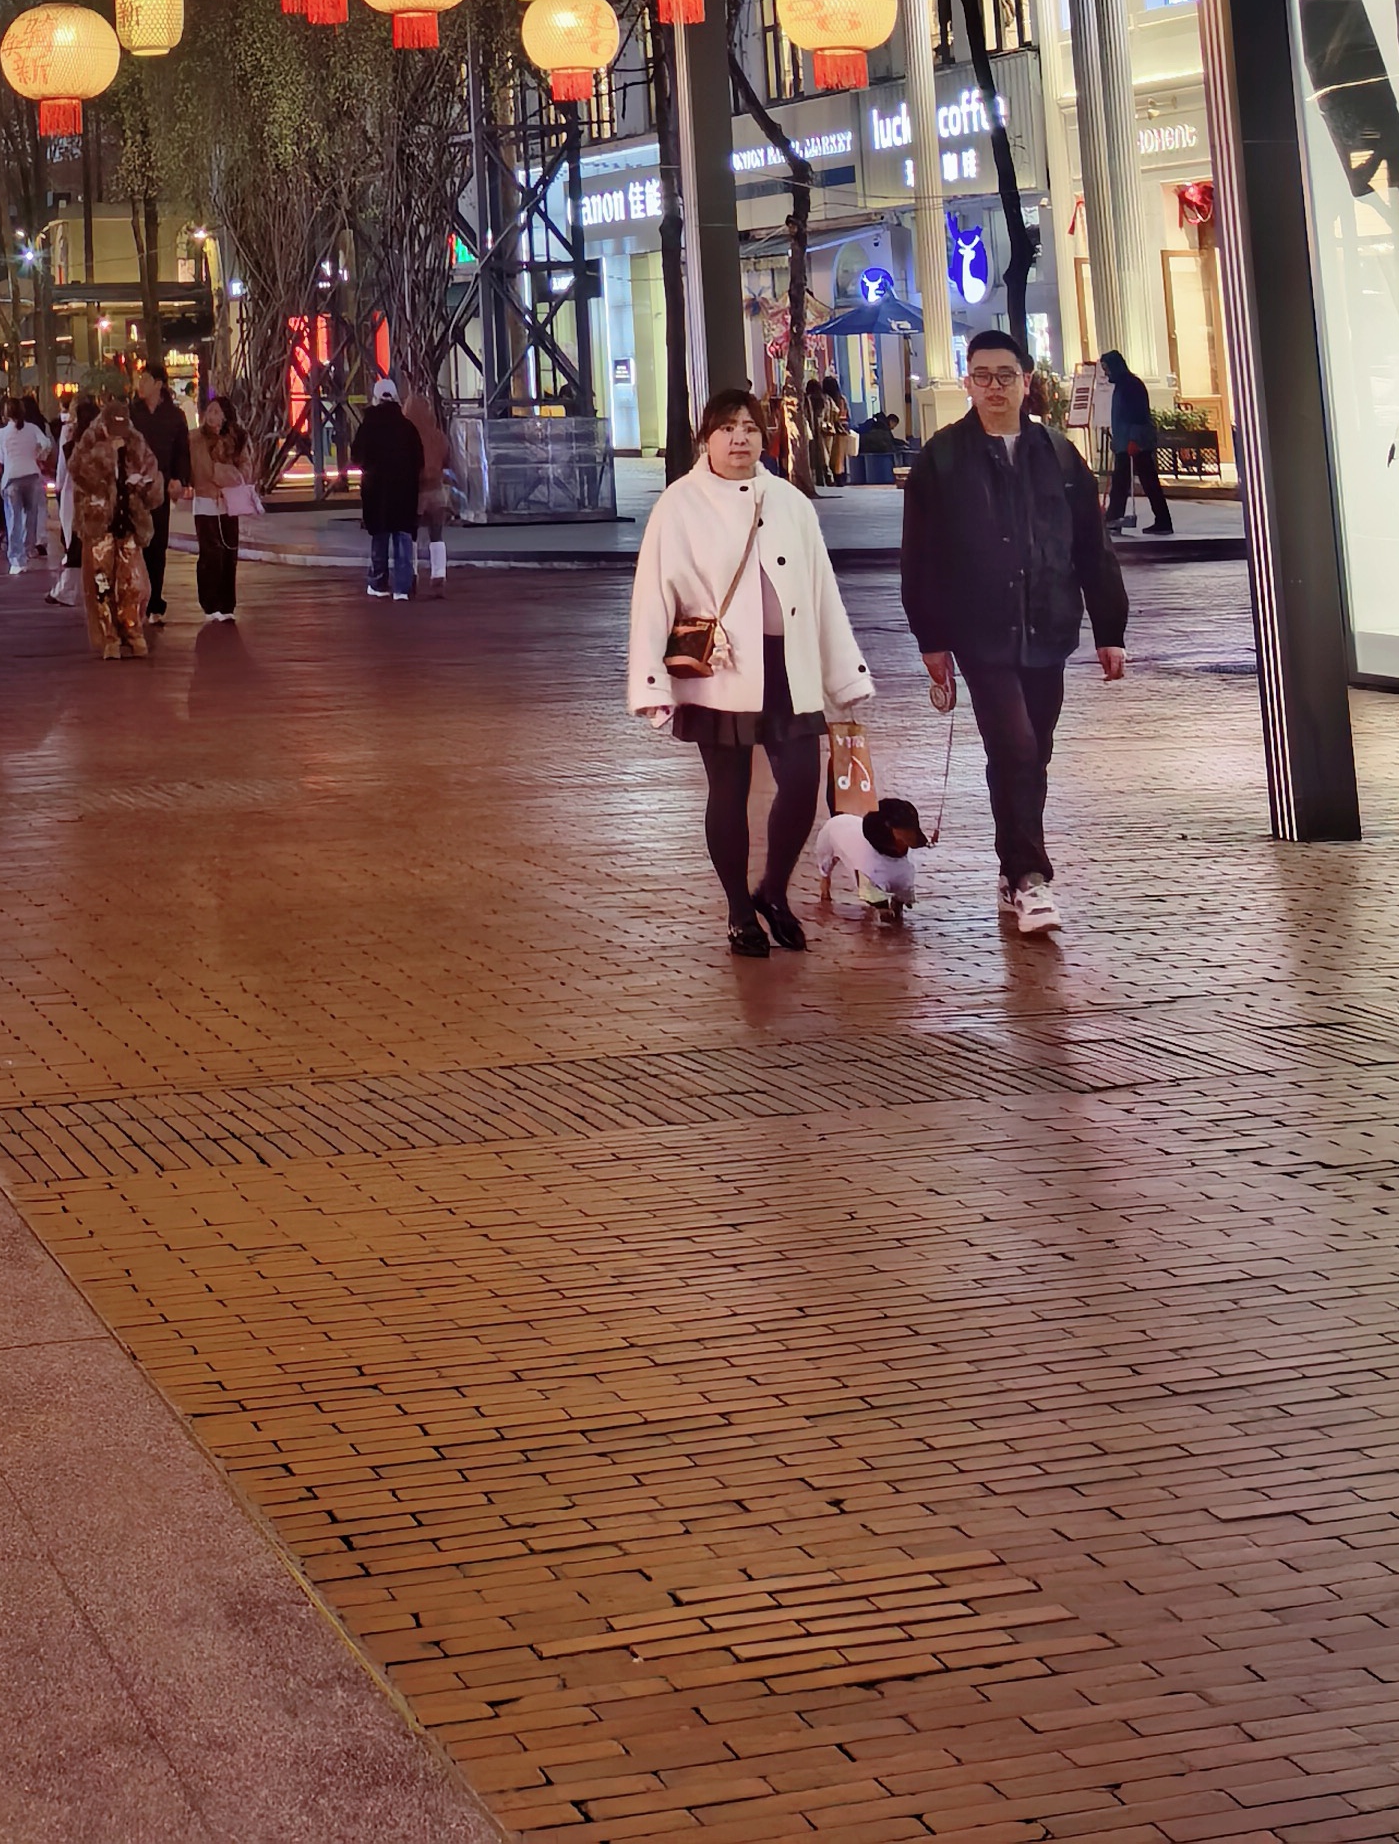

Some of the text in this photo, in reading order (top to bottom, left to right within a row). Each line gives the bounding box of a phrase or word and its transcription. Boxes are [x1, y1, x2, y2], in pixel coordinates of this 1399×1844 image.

[872, 88, 1007, 150] luck coff
[628, 178, 663, 220] 佳能
